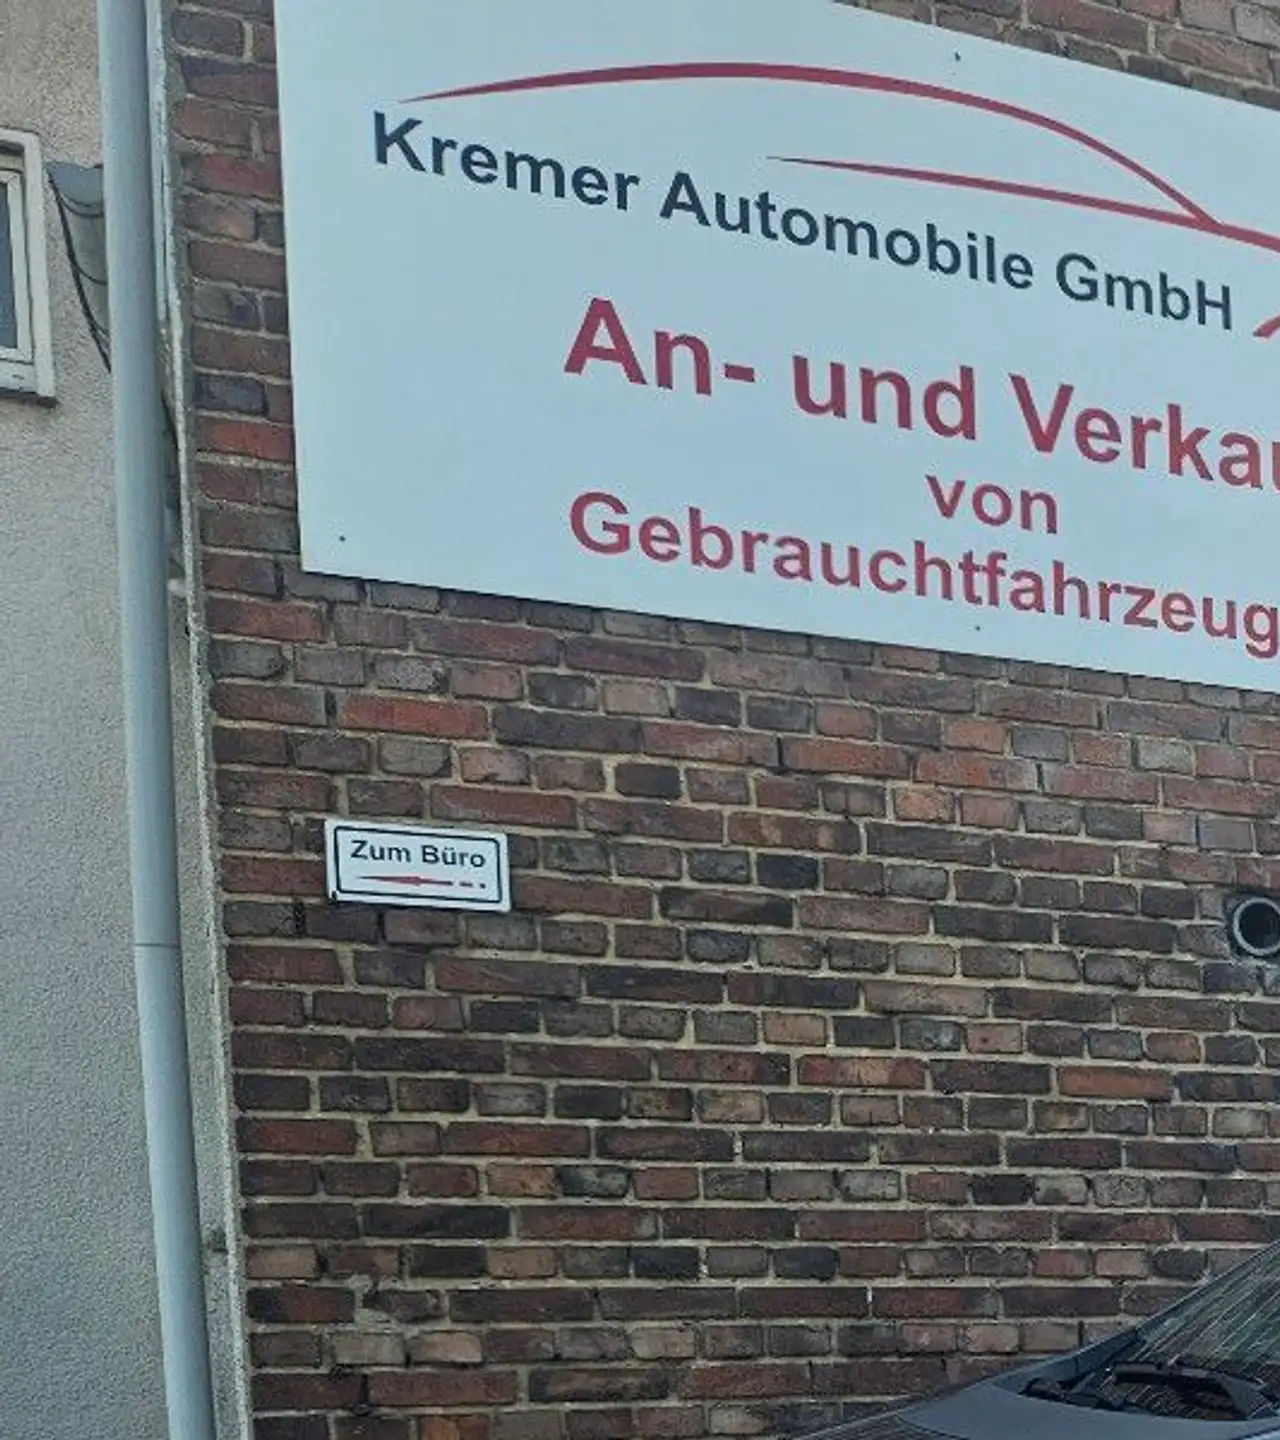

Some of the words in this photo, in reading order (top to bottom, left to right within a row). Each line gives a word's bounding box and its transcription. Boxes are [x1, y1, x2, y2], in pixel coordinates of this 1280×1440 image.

[374, 110, 642, 213] Kremer
[659, 171, 1034, 290] Automobile
[1056, 253, 1233, 331] GmbH
[564, 298, 756, 397] An-
[793, 356, 976, 441] und
[925, 475, 1058, 535] von
[351, 839, 412, 863] Zum
[421, 844, 487, 868] Büro
